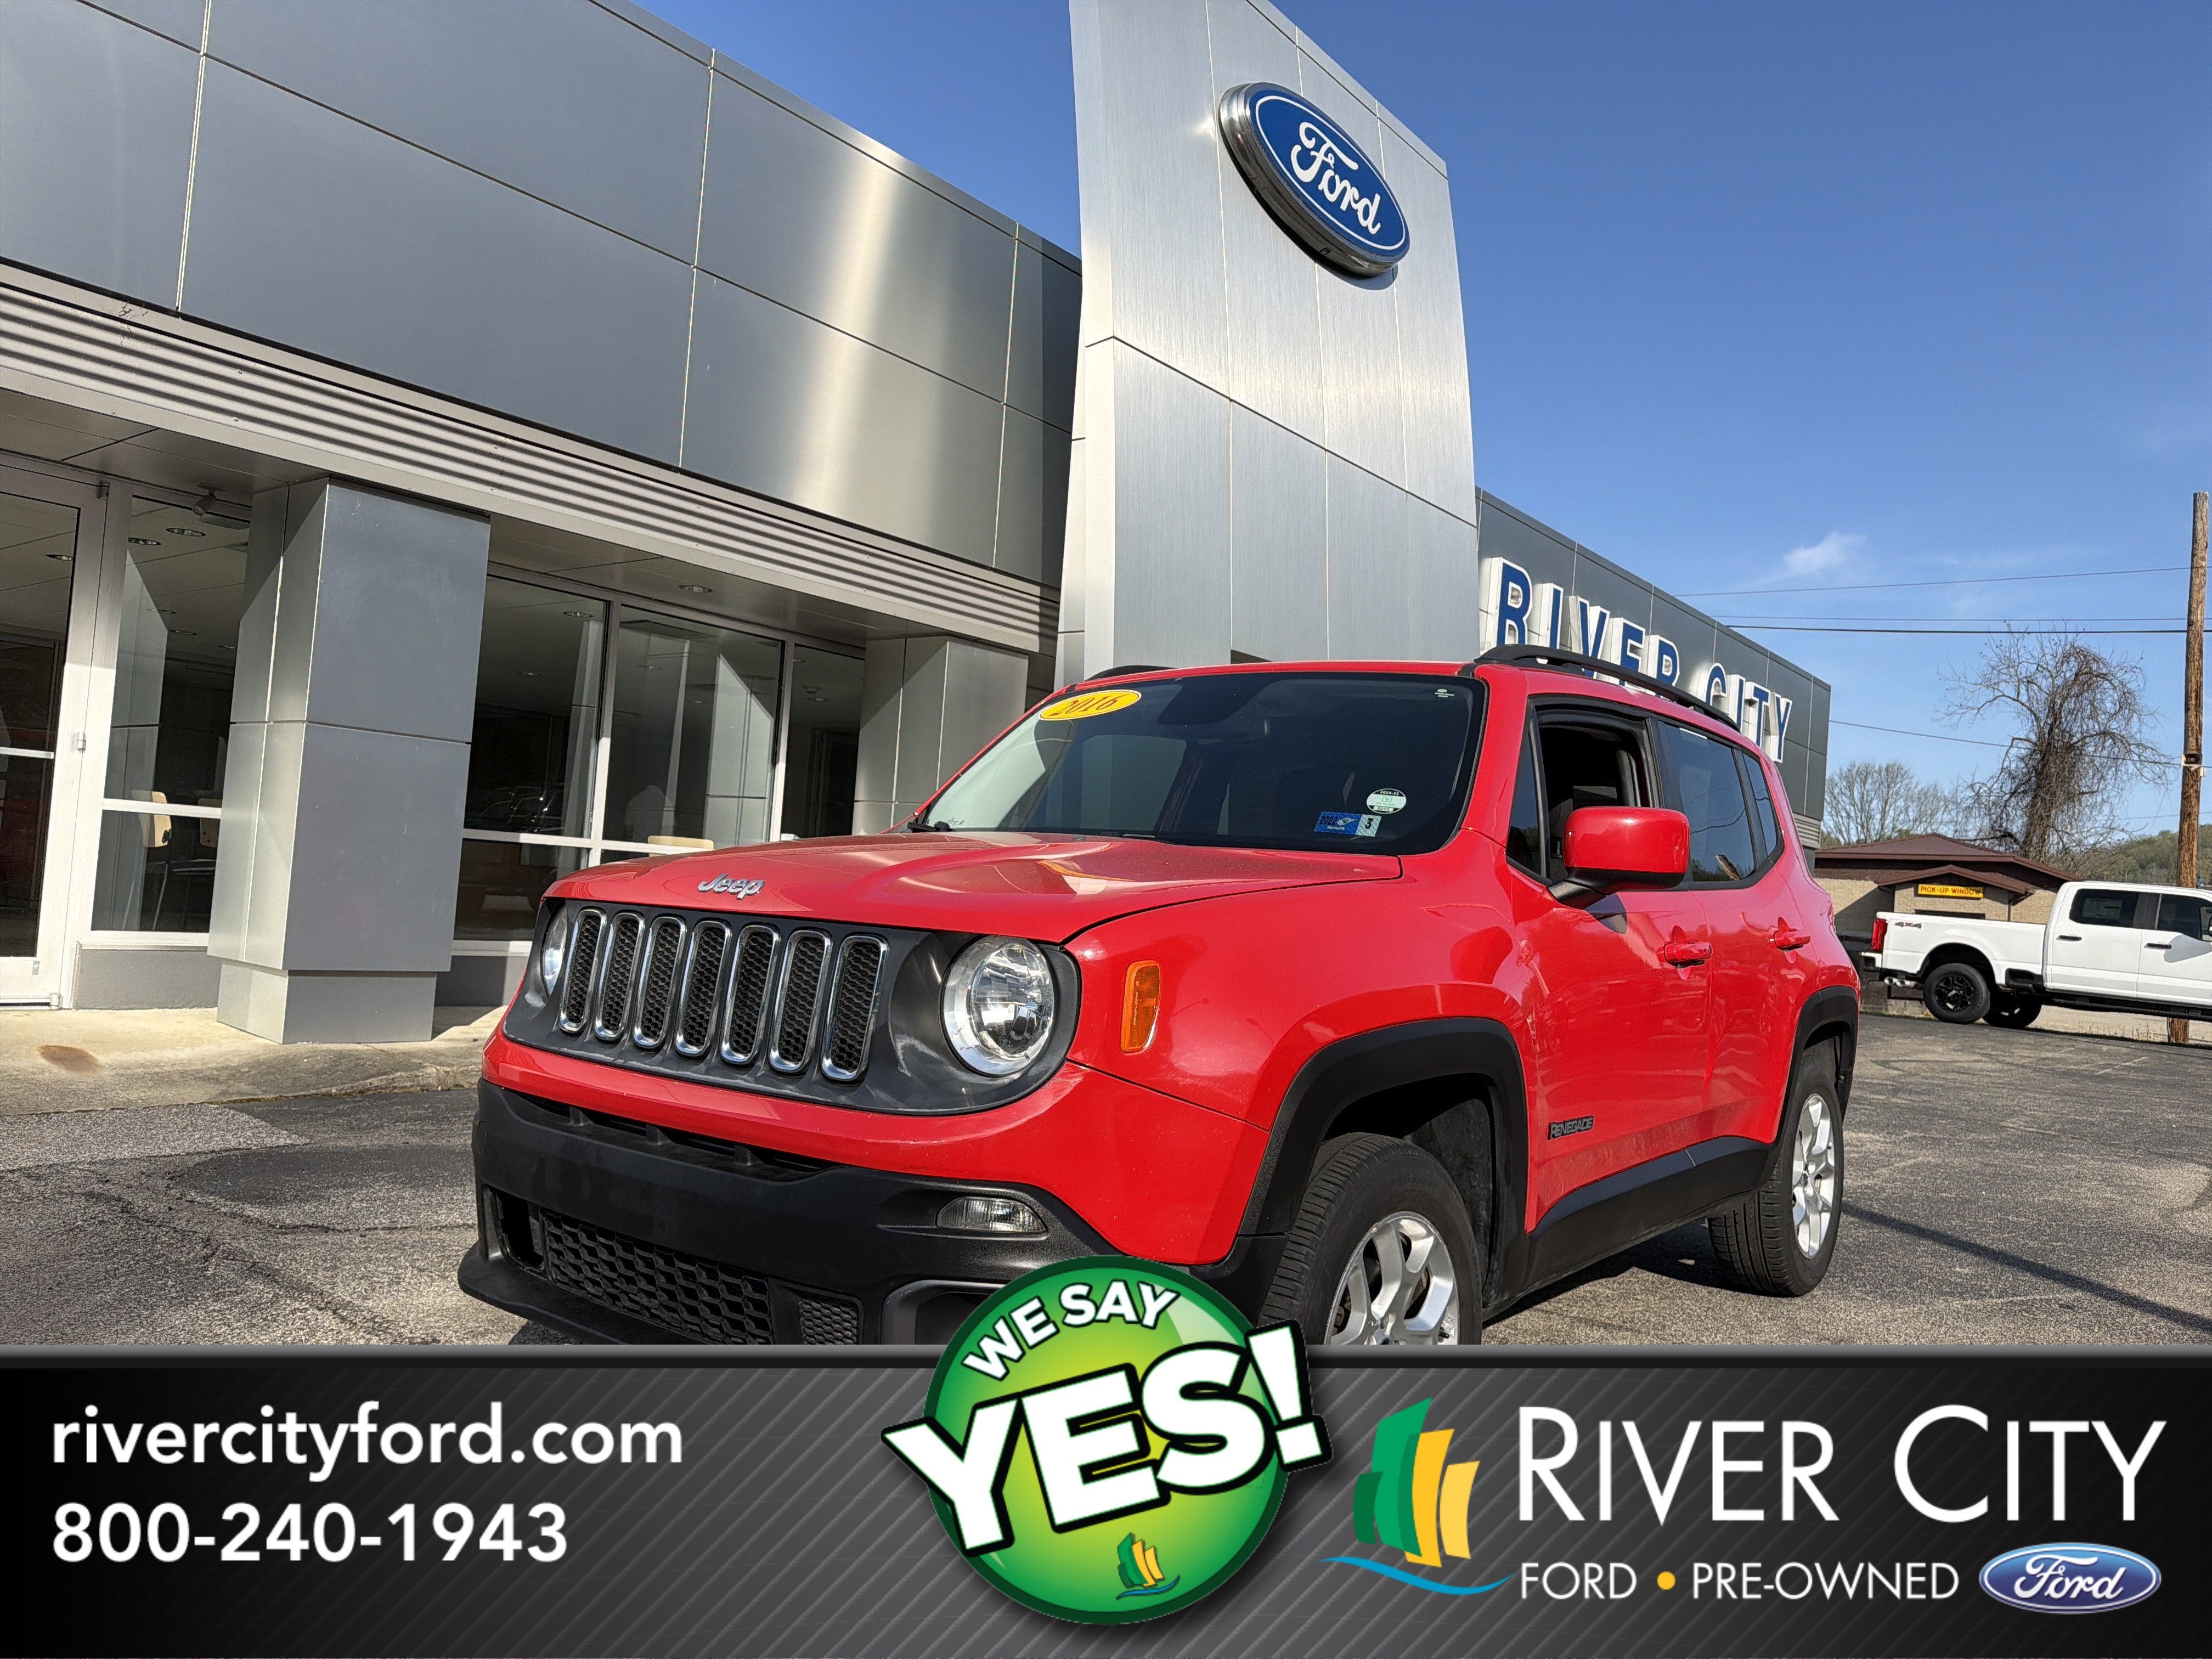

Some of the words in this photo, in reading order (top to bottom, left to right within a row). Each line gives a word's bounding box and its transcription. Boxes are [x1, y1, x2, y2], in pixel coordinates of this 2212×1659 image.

[1291, 122, 1381, 234] Ford
[1491, 557, 1680, 700] RIVER
[1701, 662, 1792, 763] CITY
[1048, 693, 1130, 717] 2016
[1364, 817, 1374, 830] 3
[698, 873, 765, 900] Jeep
[1548, 1115, 1594, 1140] RENEGADE
